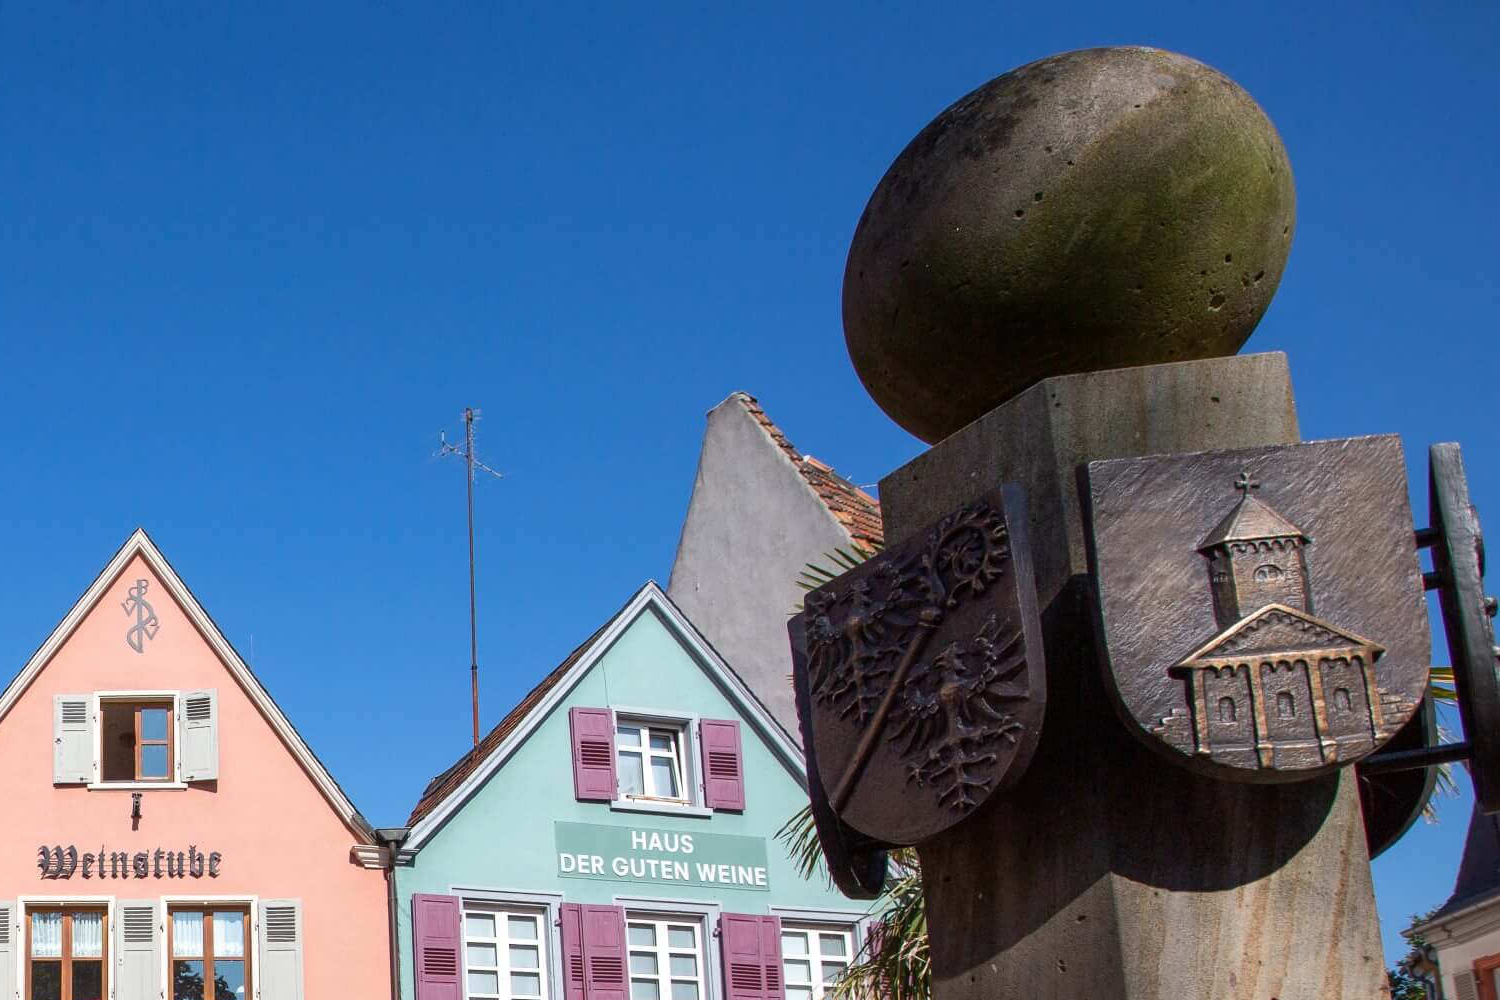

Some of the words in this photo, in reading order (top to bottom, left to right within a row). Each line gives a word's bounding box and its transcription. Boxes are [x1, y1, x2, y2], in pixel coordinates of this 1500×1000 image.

[631, 831, 694, 854] HAUS
[37, 844, 222, 880] Weinstube
[560, 853, 605, 875] DER
[612, 857, 690, 881] GUTEN
[697, 863, 767, 886] WEINE
